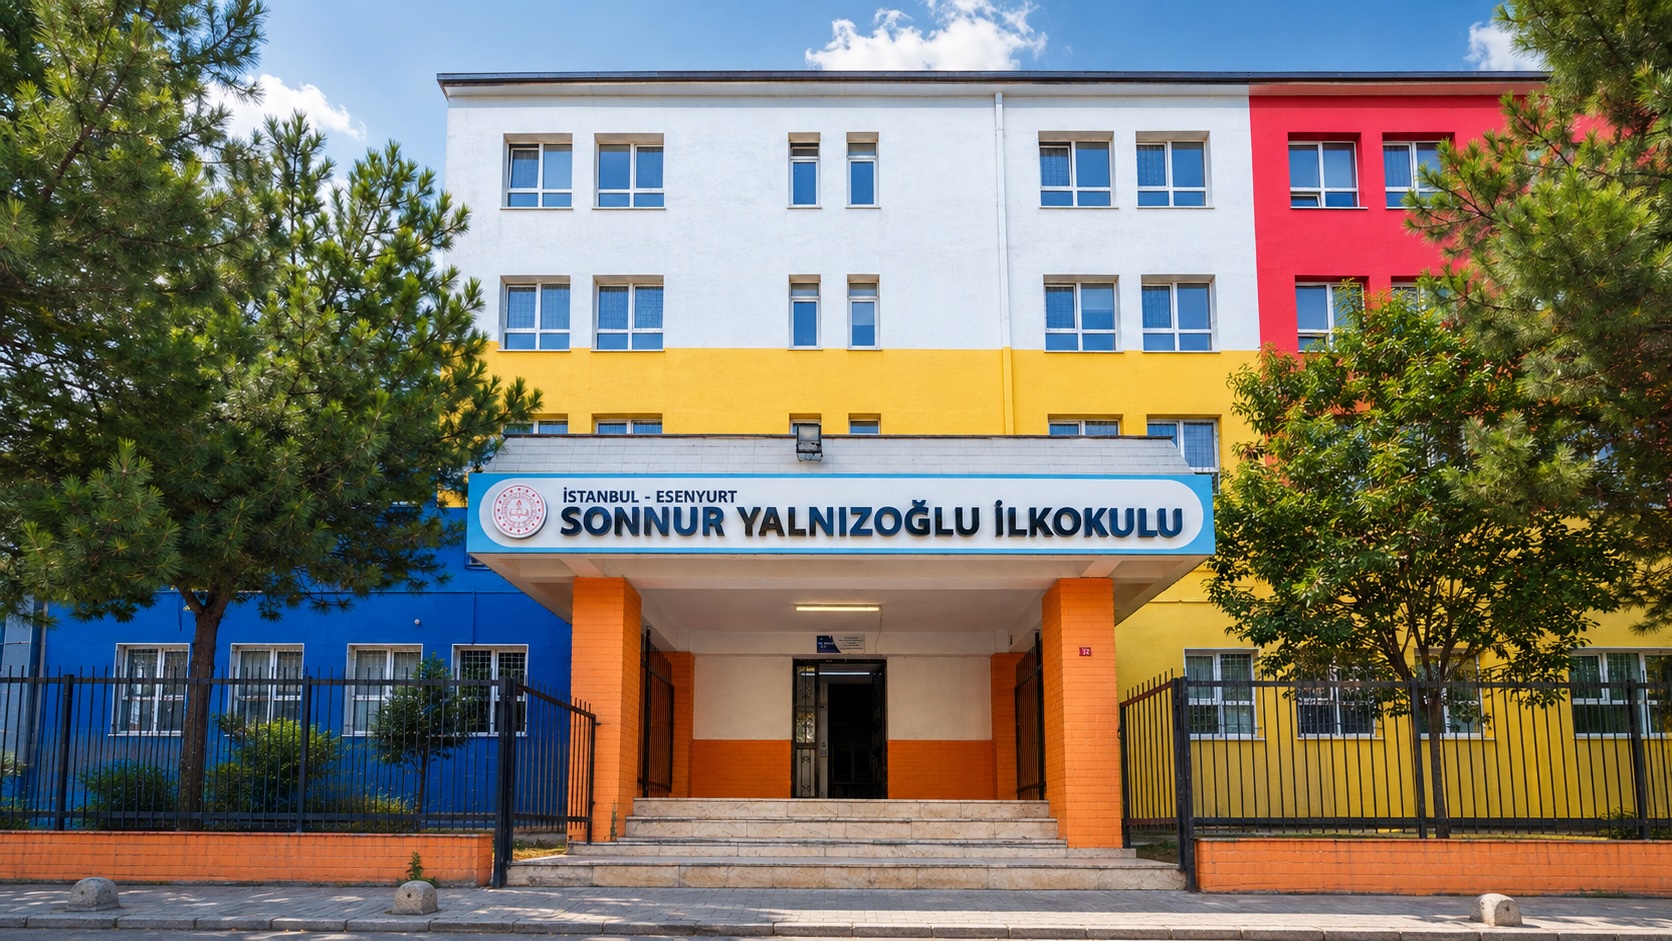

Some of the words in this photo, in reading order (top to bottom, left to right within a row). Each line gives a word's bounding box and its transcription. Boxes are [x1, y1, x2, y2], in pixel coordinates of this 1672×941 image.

[562, 487, 639, 503] İSTANBUL
[656, 490, 738, 503] ESENYURT
[560, 506, 725, 537] SONNUR
[737, 499, 980, 538] YALNIZOĞLU
[994, 499, 1184, 538] İLKOKULU
